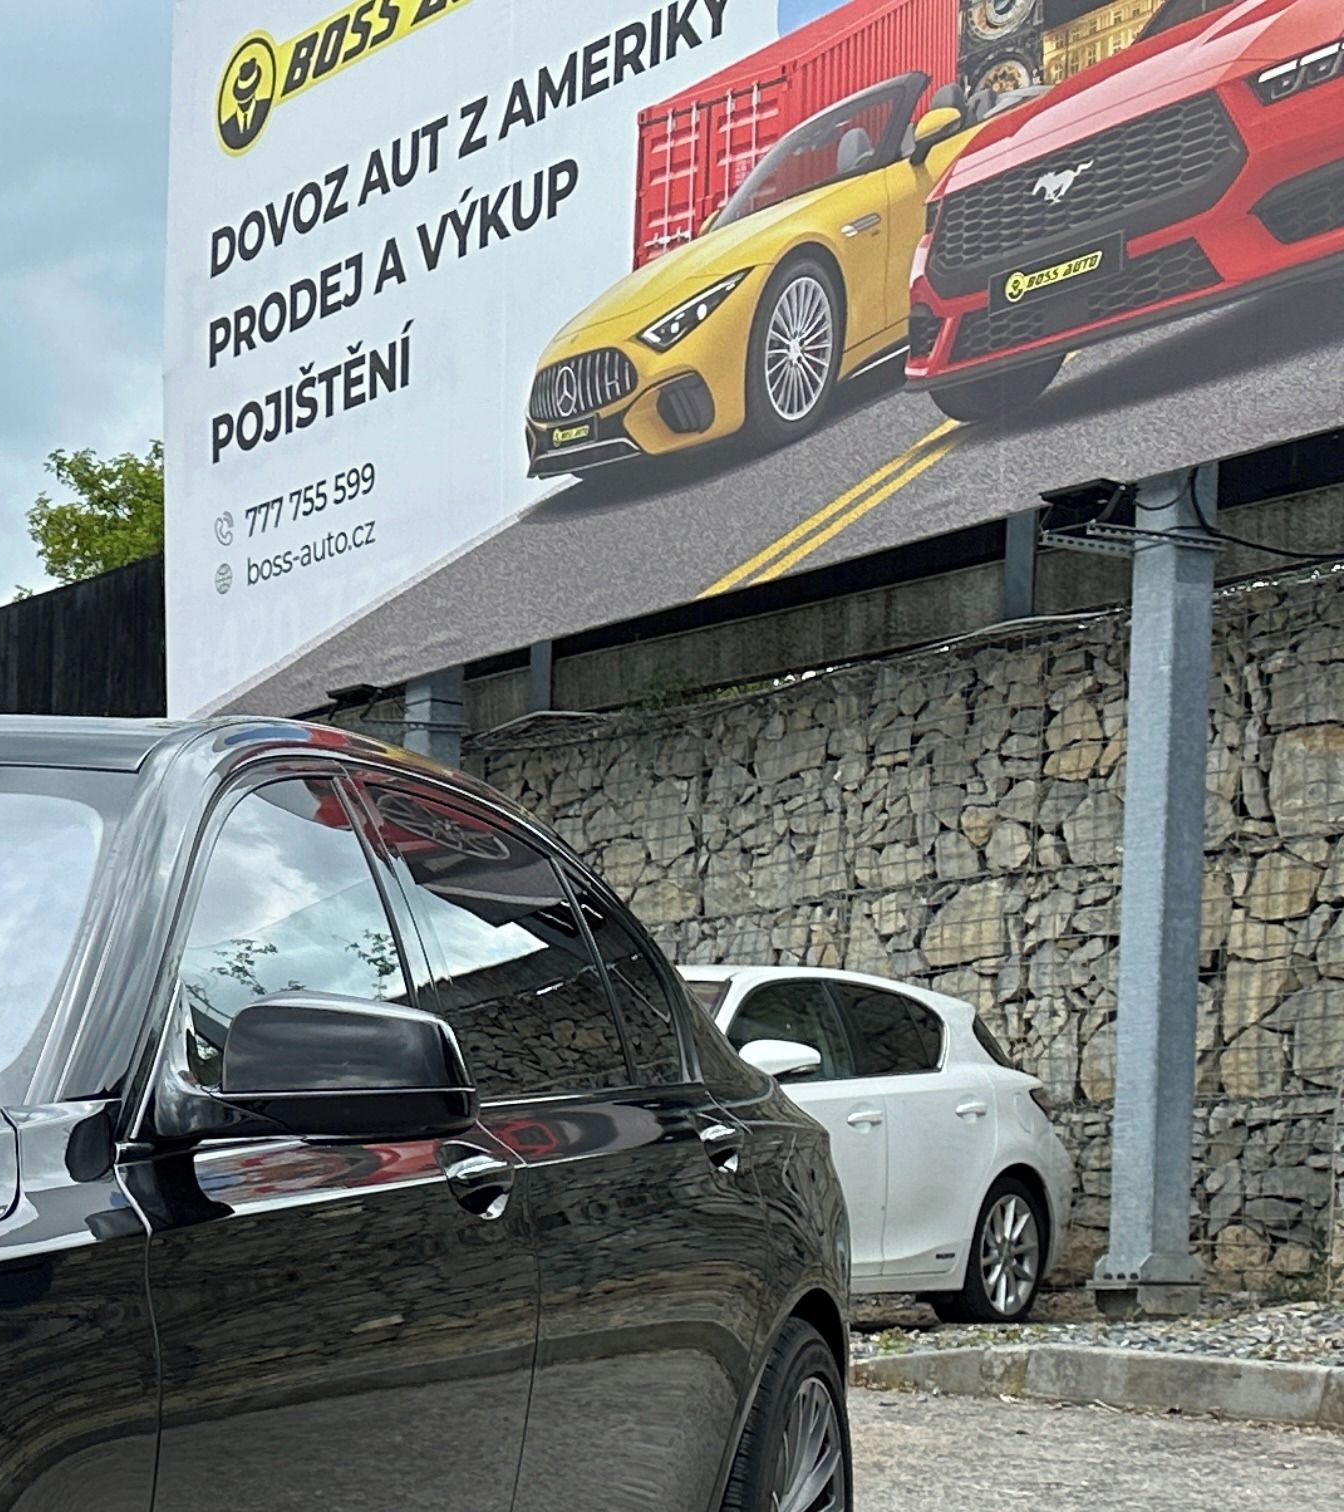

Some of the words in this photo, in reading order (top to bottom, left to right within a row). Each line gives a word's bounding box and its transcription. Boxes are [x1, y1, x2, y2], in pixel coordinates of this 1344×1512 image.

[281, 0, 400, 97] BOSS
[210, 164, 349, 279] DOVOZ
[358, 114, 449, 207] AUT
[458, 95, 488, 159] Z
[498, 0, 727, 141] AMERIKY
[209, 252, 363, 368] PRODEJ
[374, 237, 407, 295] A
[416, 158, 579, 271] VÝKUP
[212, 319, 414, 464] POJIŠTĚNÍ
[245, 496, 284, 538] 777
[289, 480, 327, 522] 755
[334, 462, 376, 505] 599
[247, 520, 376, 587] boss-auto.cz
